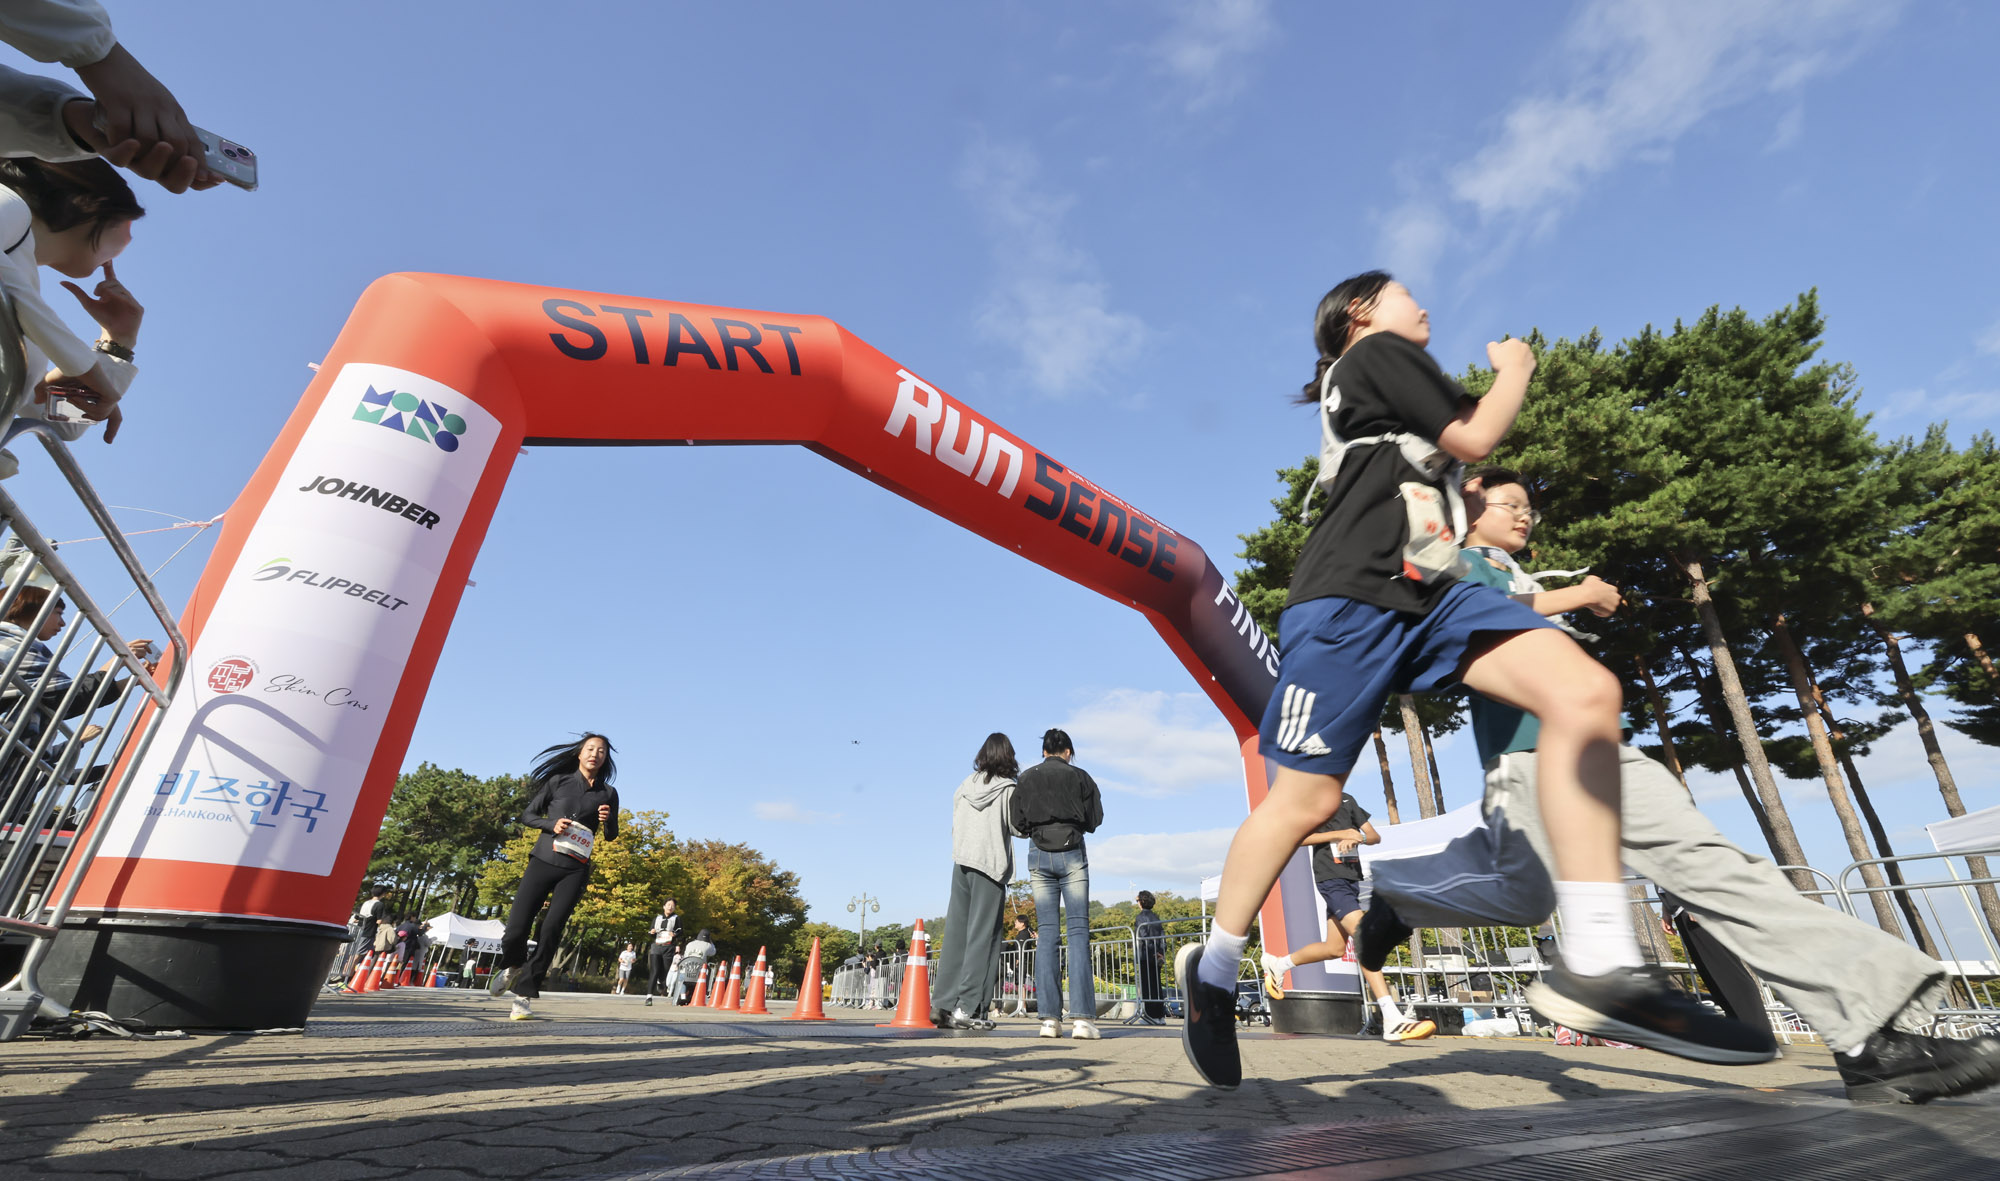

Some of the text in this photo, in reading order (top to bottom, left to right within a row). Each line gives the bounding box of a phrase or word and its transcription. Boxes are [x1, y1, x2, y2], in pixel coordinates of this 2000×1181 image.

[541, 298, 802, 376] START
[299, 476, 441, 530] JOHNBER
[286, 570, 409, 611] FLIPBELT
[1214, 579, 1280, 678] FINIS
[263, 674, 320, 693] Skin
[153, 770, 329, 833] 비즈한국
[570, 833, 592, 848] 6195
